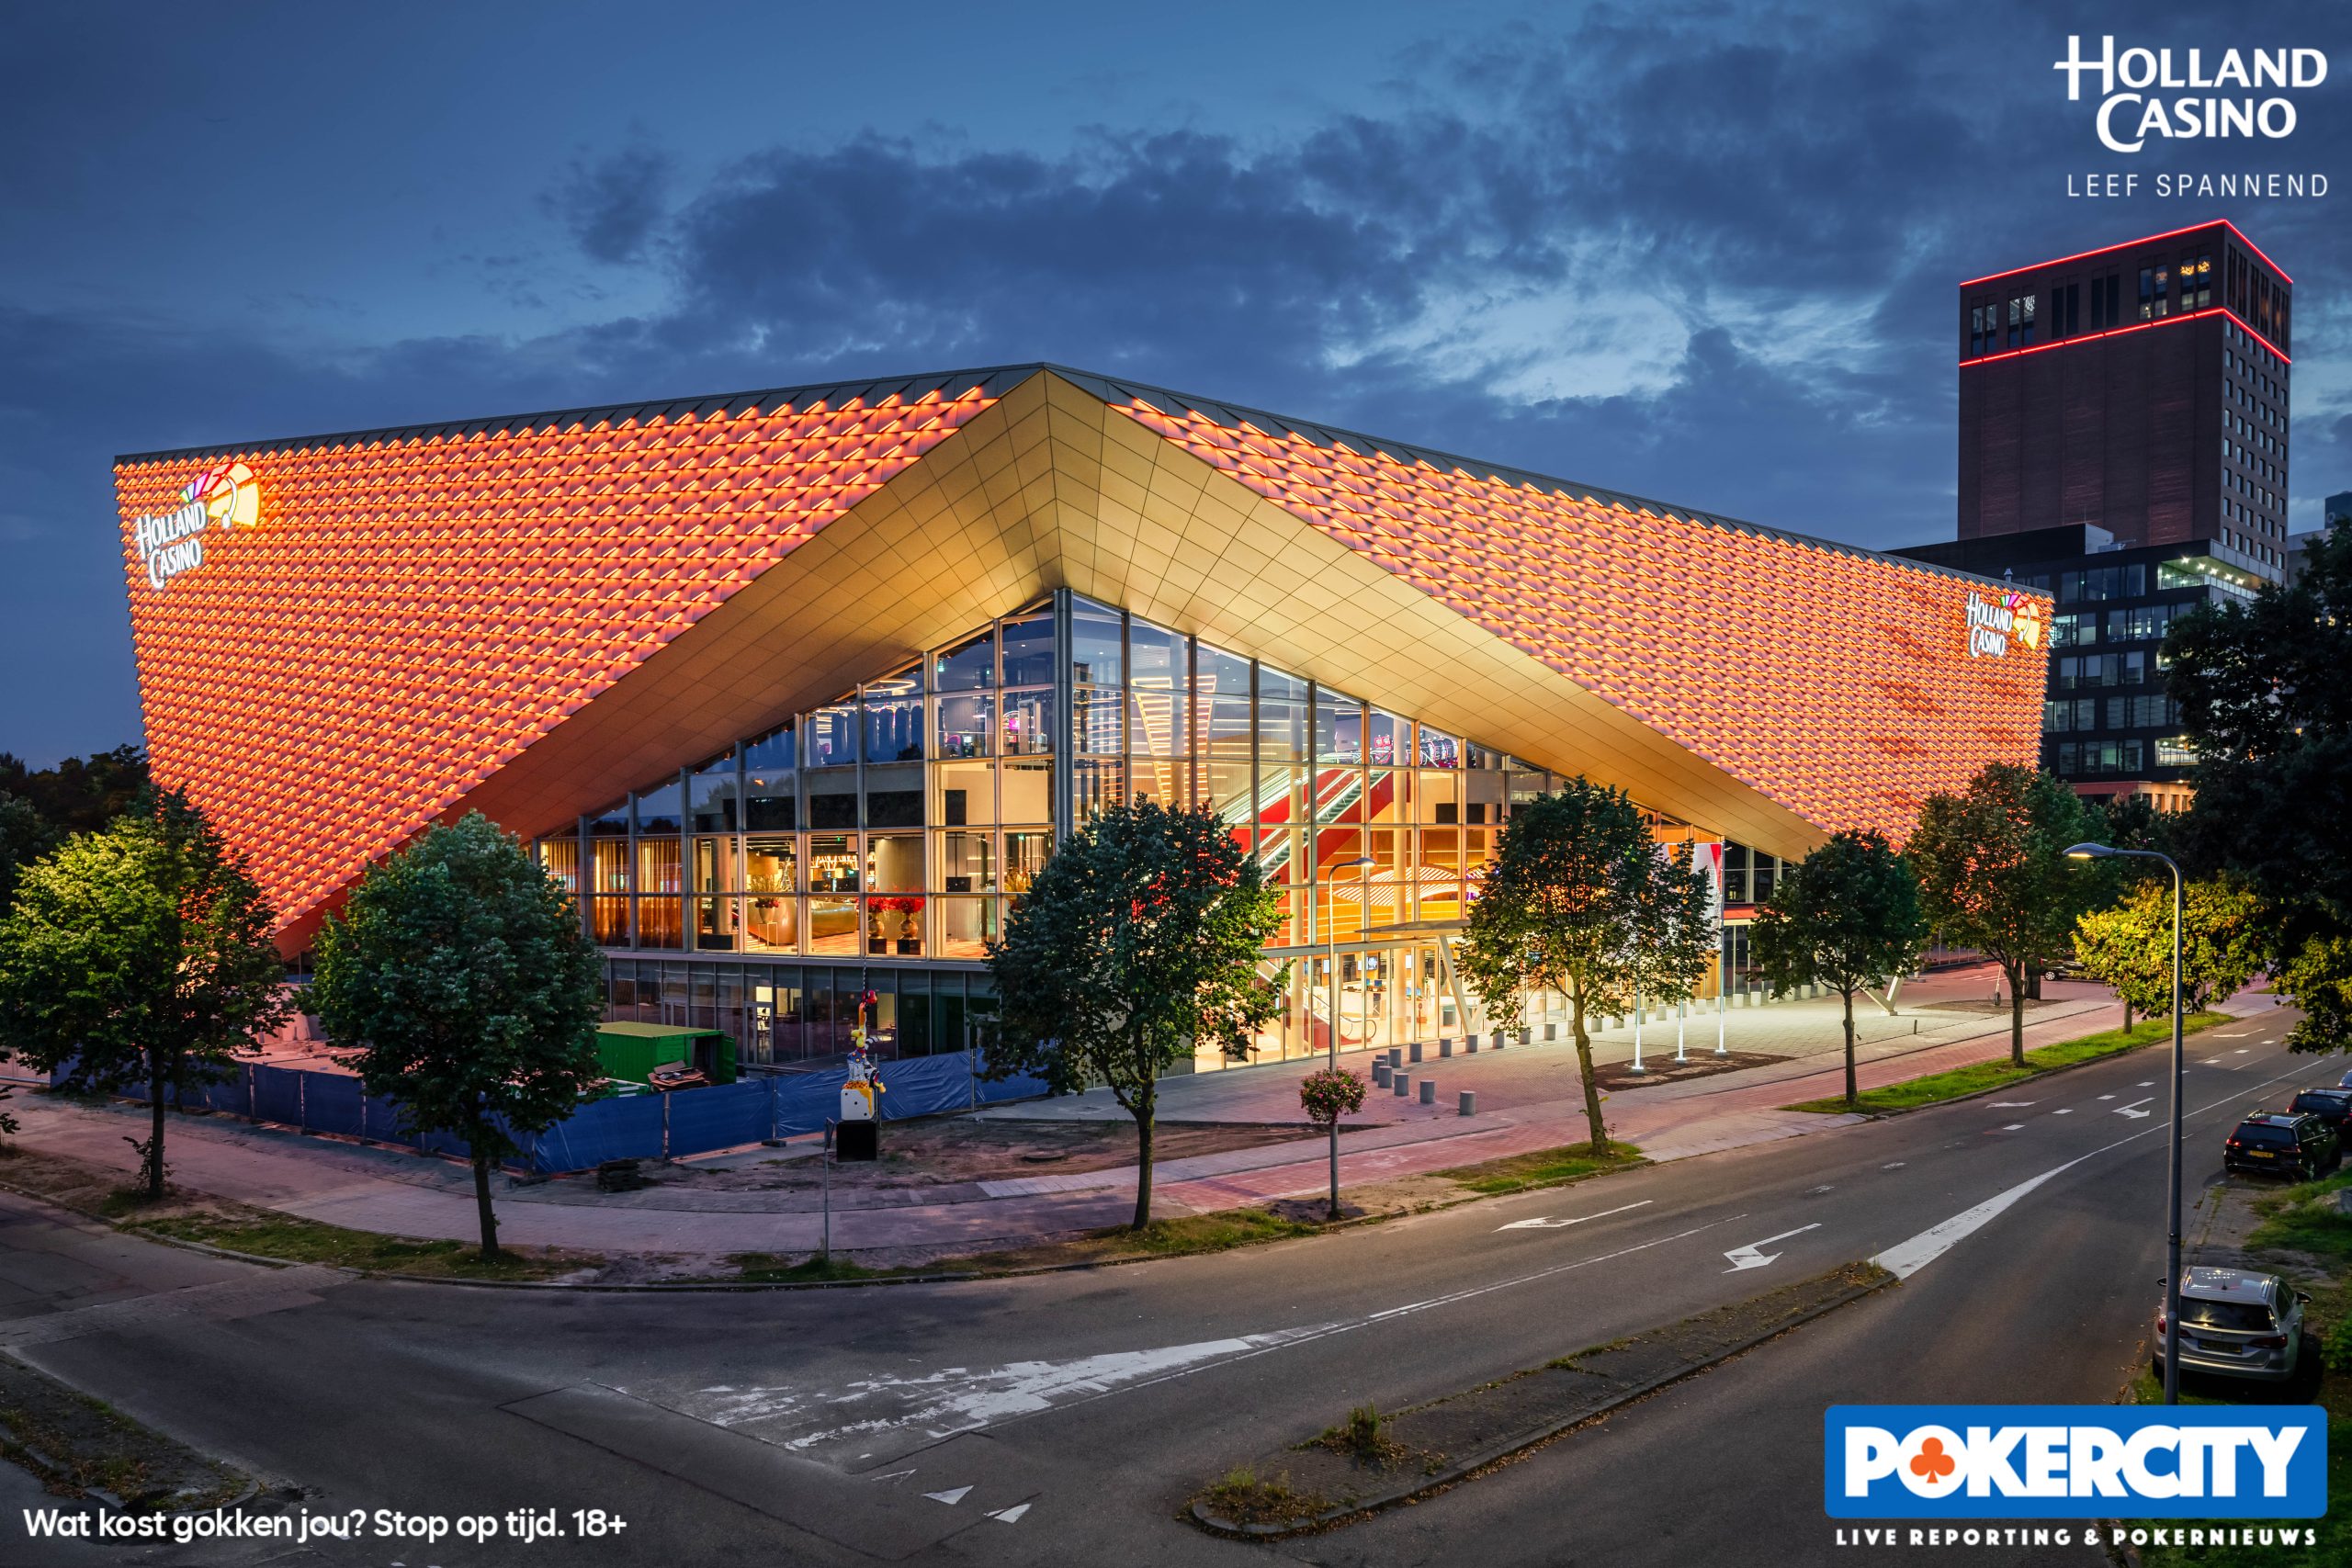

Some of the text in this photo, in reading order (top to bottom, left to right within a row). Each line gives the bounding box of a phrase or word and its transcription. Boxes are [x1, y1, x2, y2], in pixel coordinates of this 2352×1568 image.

[136, 501, 207, 560] HOLLAND
[149, 537, 202, 590] CASINO
[1965, 591, 2013, 632] HOLLAND
[1970, 626, 2006, 658] CASINO
